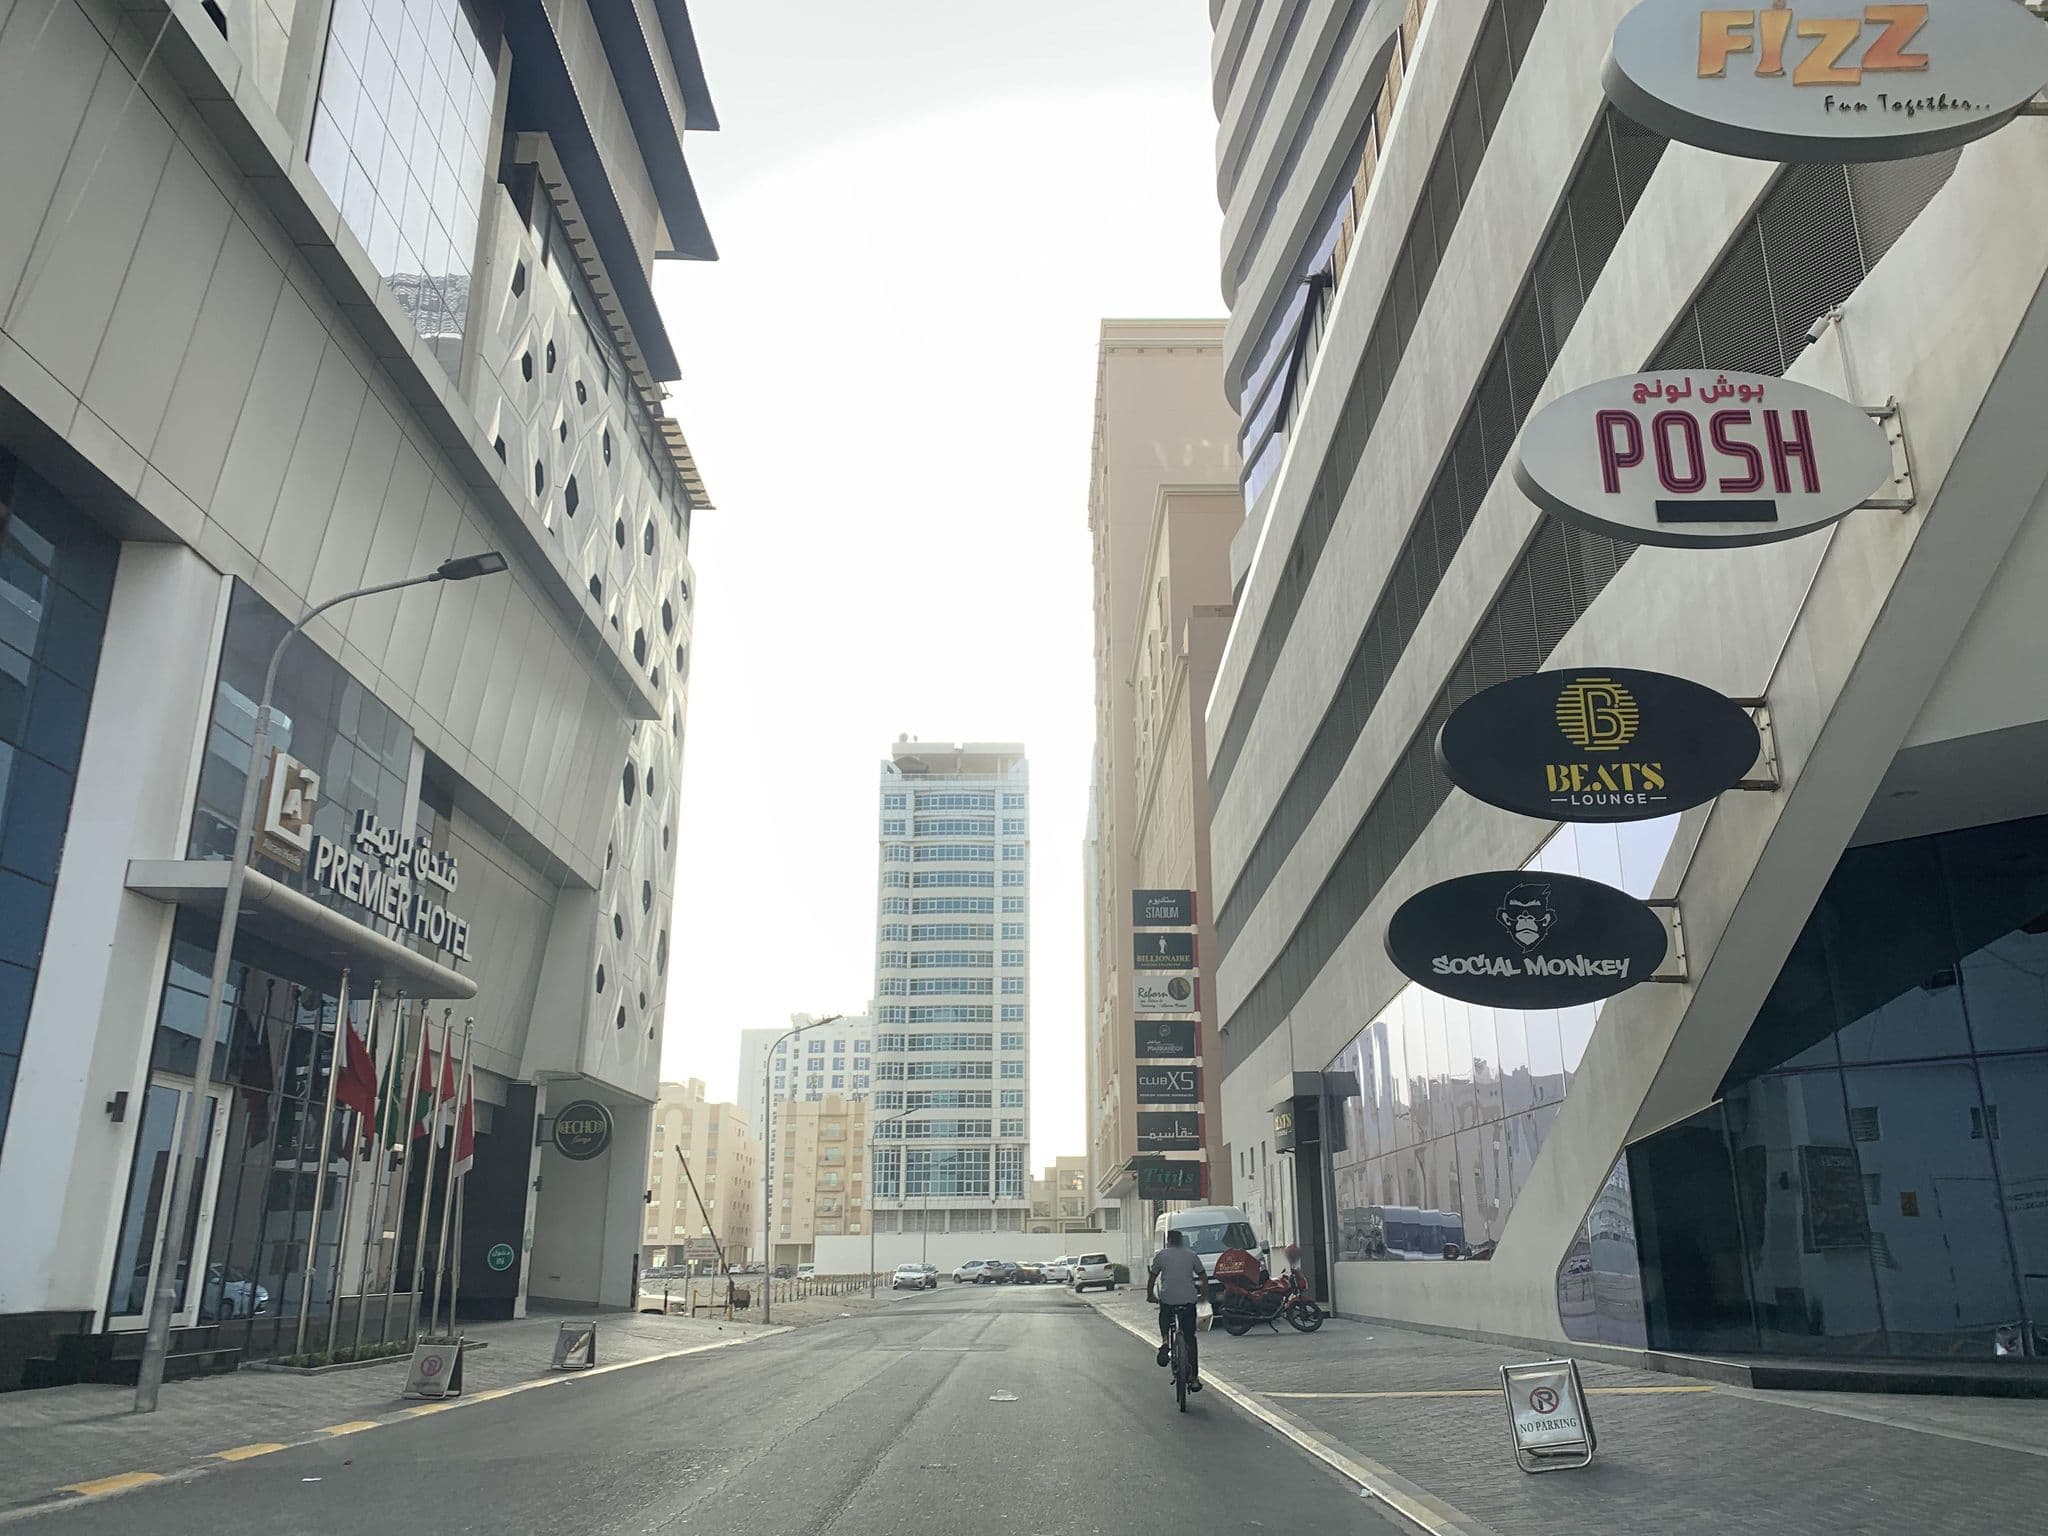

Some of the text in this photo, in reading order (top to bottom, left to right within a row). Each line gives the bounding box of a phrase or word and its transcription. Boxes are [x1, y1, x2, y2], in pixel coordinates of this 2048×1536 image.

[1824, 96, 1868, 113] Fun
[1632, 375, 1765, 404] بوش لونج
[1596, 410, 1821, 494] POSH
[1546, 762, 1665, 792] BEATS
[1571, 793, 1648, 806] LOUNGE
[312, 835, 473, 962] PREMIER HOTEL
[1145, 906, 1179, 919] STADIUM
[1432, 954, 1630, 979] SOCIAL MONKEY
[1137, 986, 1169, 1000] Reborn
[1139, 1071, 1194, 1090] CLUB XS
[1520, 1418, 1577, 1433] NO PARKING
